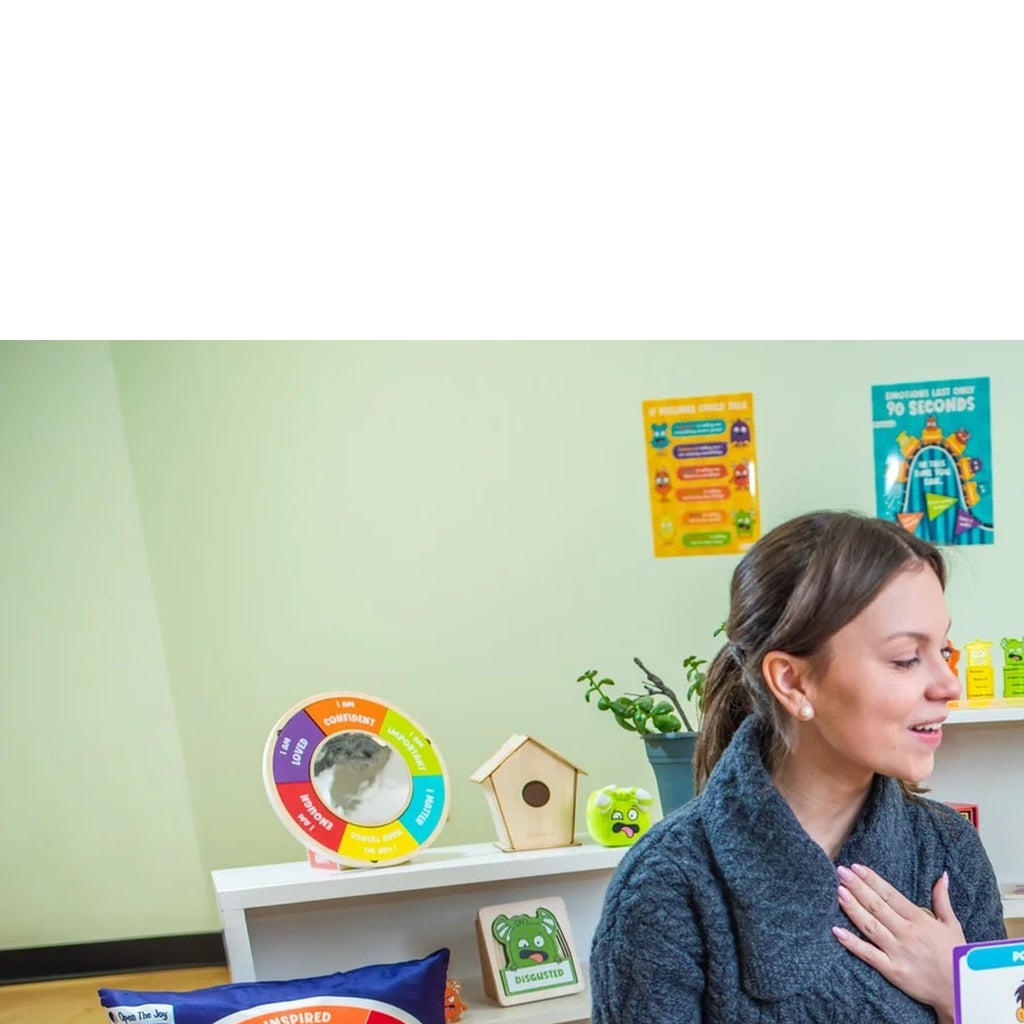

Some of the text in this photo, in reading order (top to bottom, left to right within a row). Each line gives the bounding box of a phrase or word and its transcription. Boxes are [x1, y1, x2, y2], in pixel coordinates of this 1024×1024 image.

[886, 396, 975, 416] 90 SECONDS
[323, 713, 376, 727] CONFIDENT
[281, 737, 292, 750] AM
[291, 737, 309, 766] LOVED
[387, 727, 427, 771] IMPORTANT
[297, 813, 311, 827] AM
[300, 794, 334, 832] ENOUGH
[415, 794, 434, 826] MATTER
[118, 1009, 168, 1024] Open The Joy
